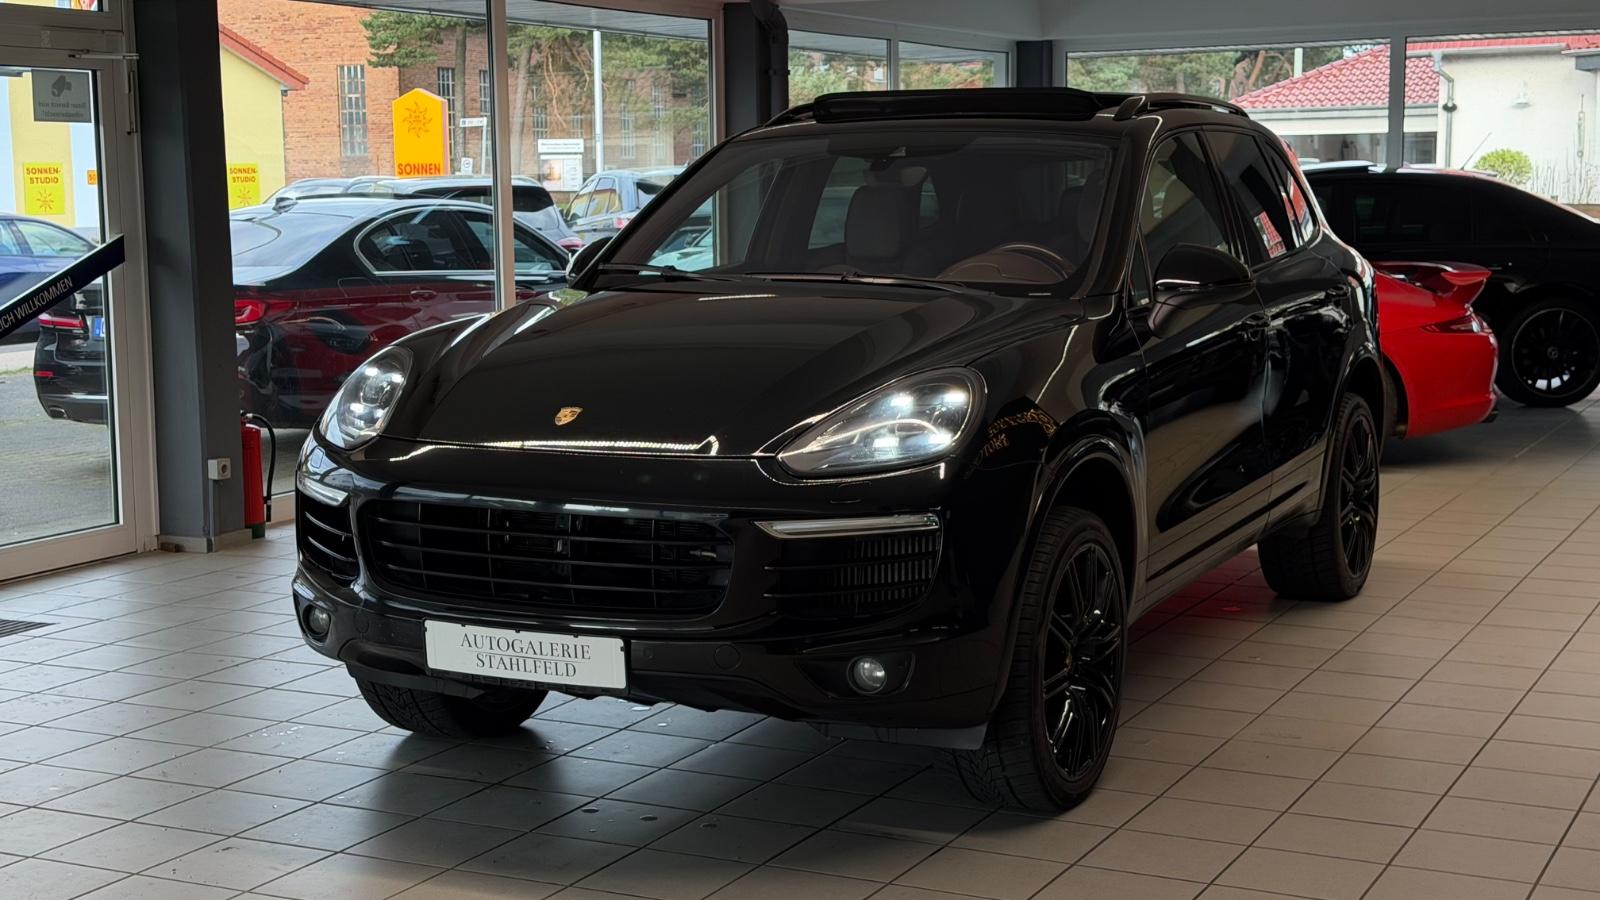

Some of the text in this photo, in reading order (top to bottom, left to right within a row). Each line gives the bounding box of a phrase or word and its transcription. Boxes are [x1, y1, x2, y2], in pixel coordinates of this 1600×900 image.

[29, 176, 59, 185] STUDIO
[397, 162, 441, 176] SONNEN
[14, 275, 74, 320] WILLKOMMEN
[460, 633, 591, 660] AUTOGALERIE
[476, 653, 577, 678] STAHLFELD
